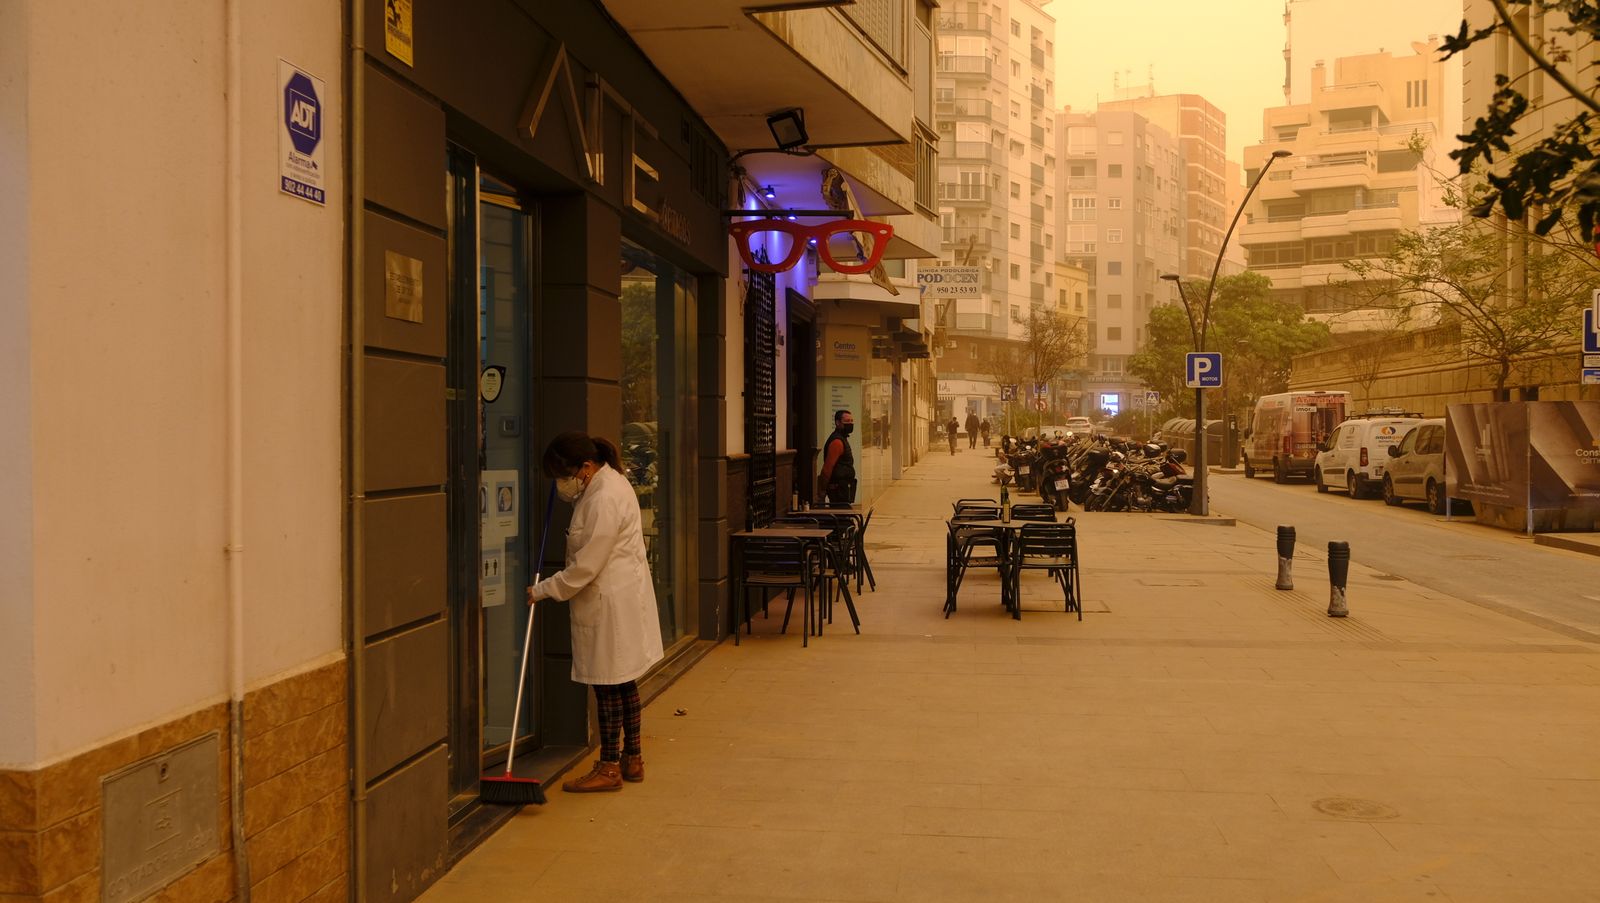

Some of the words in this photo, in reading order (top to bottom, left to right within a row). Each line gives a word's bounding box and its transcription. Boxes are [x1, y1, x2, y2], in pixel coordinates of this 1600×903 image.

[291, 99, 316, 131] ADT
[296, 183, 304, 196] 44
[917, 273, 979, 283] PODOCEN
[936, 286, 949, 294] 950
[950, 286, 958, 294] 23
[959, 286, 968, 294] 53
[968, 286, 977, 294] 93
[834, 341, 856, 350] Centro
[1194, 357, 1212, 385] P
